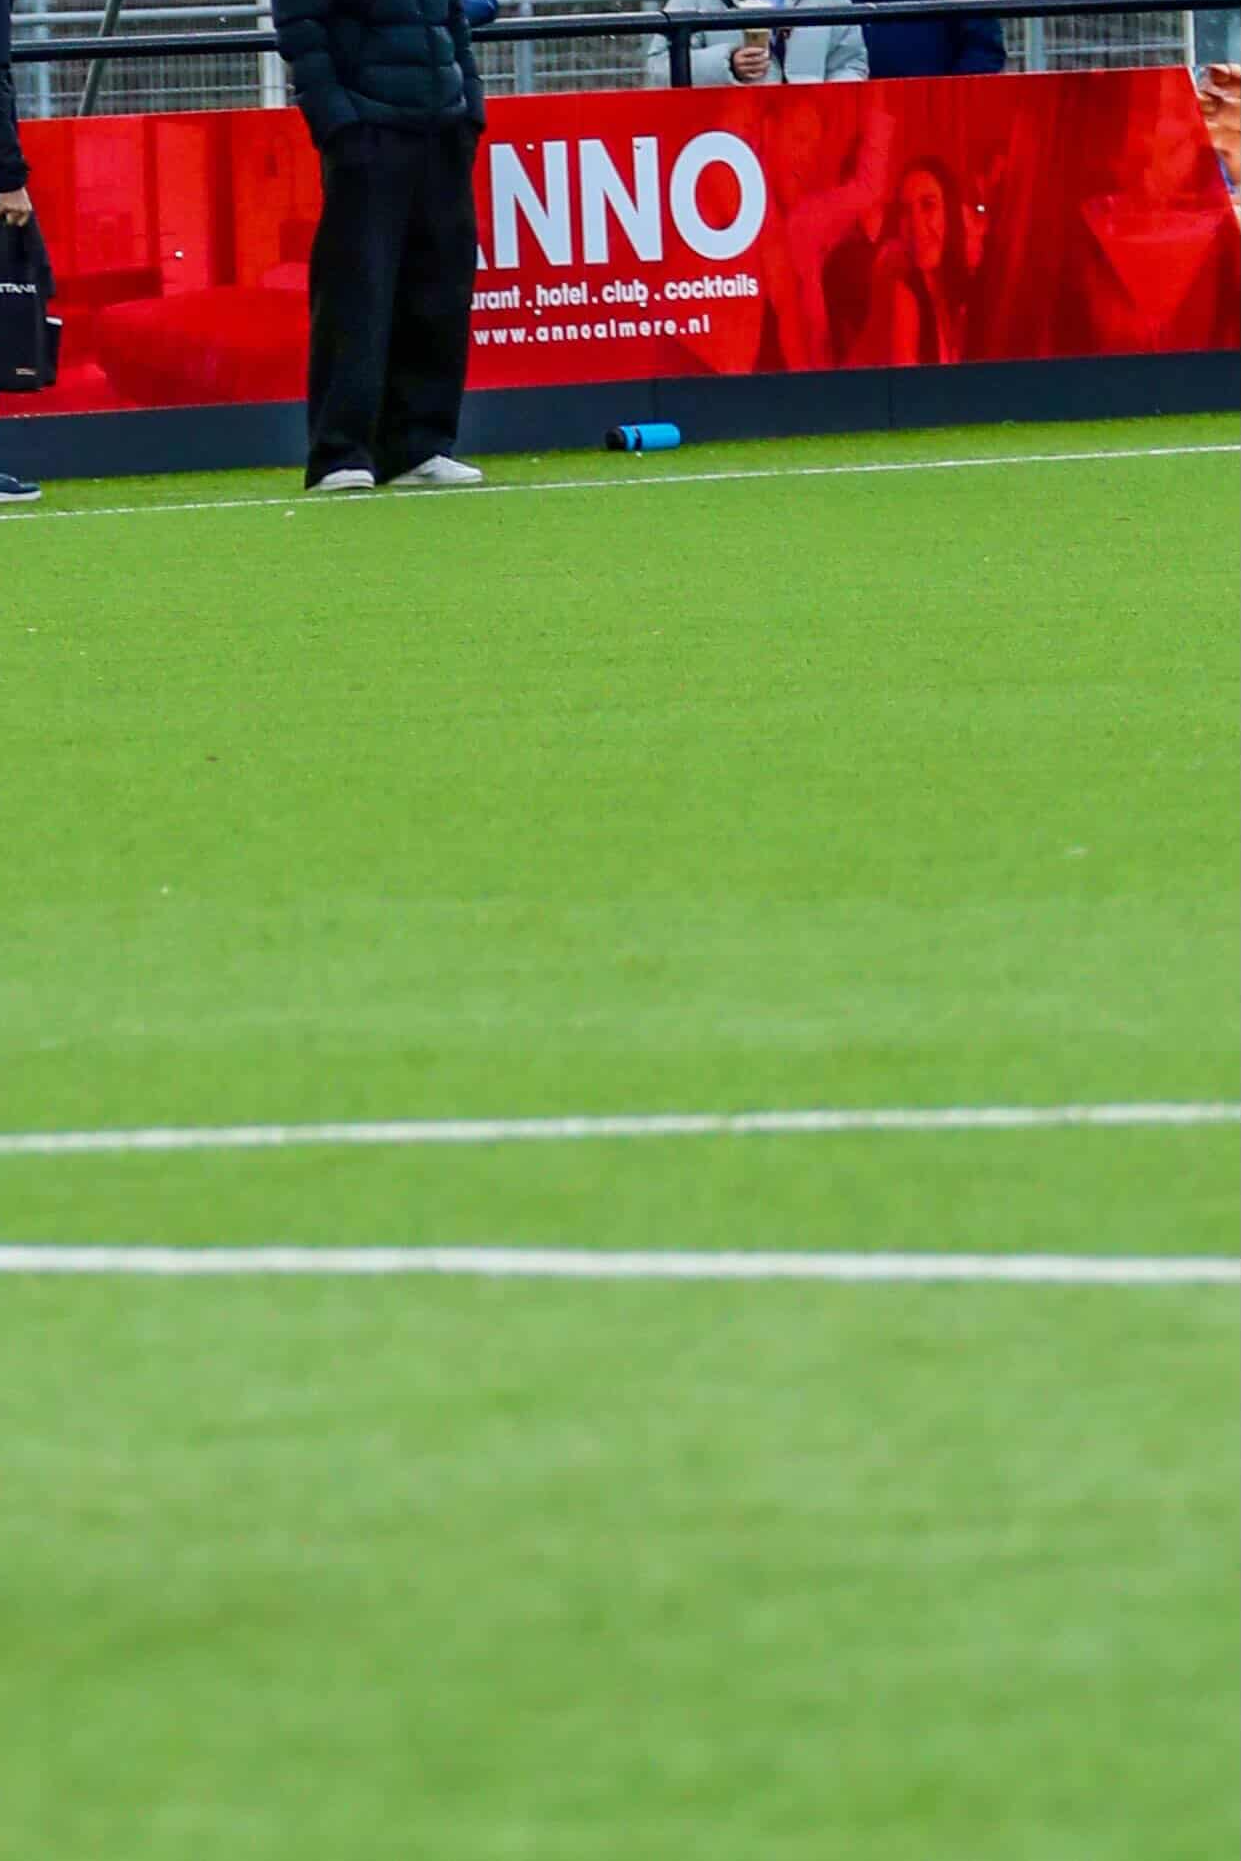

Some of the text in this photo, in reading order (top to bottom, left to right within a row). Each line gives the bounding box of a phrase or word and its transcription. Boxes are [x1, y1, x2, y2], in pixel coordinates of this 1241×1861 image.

[476, 131, 767, 270] NNO
[470, 273, 759, 311] urant hotel club cocktails
[473, 314, 710, 345] www.annoalmere.nl
